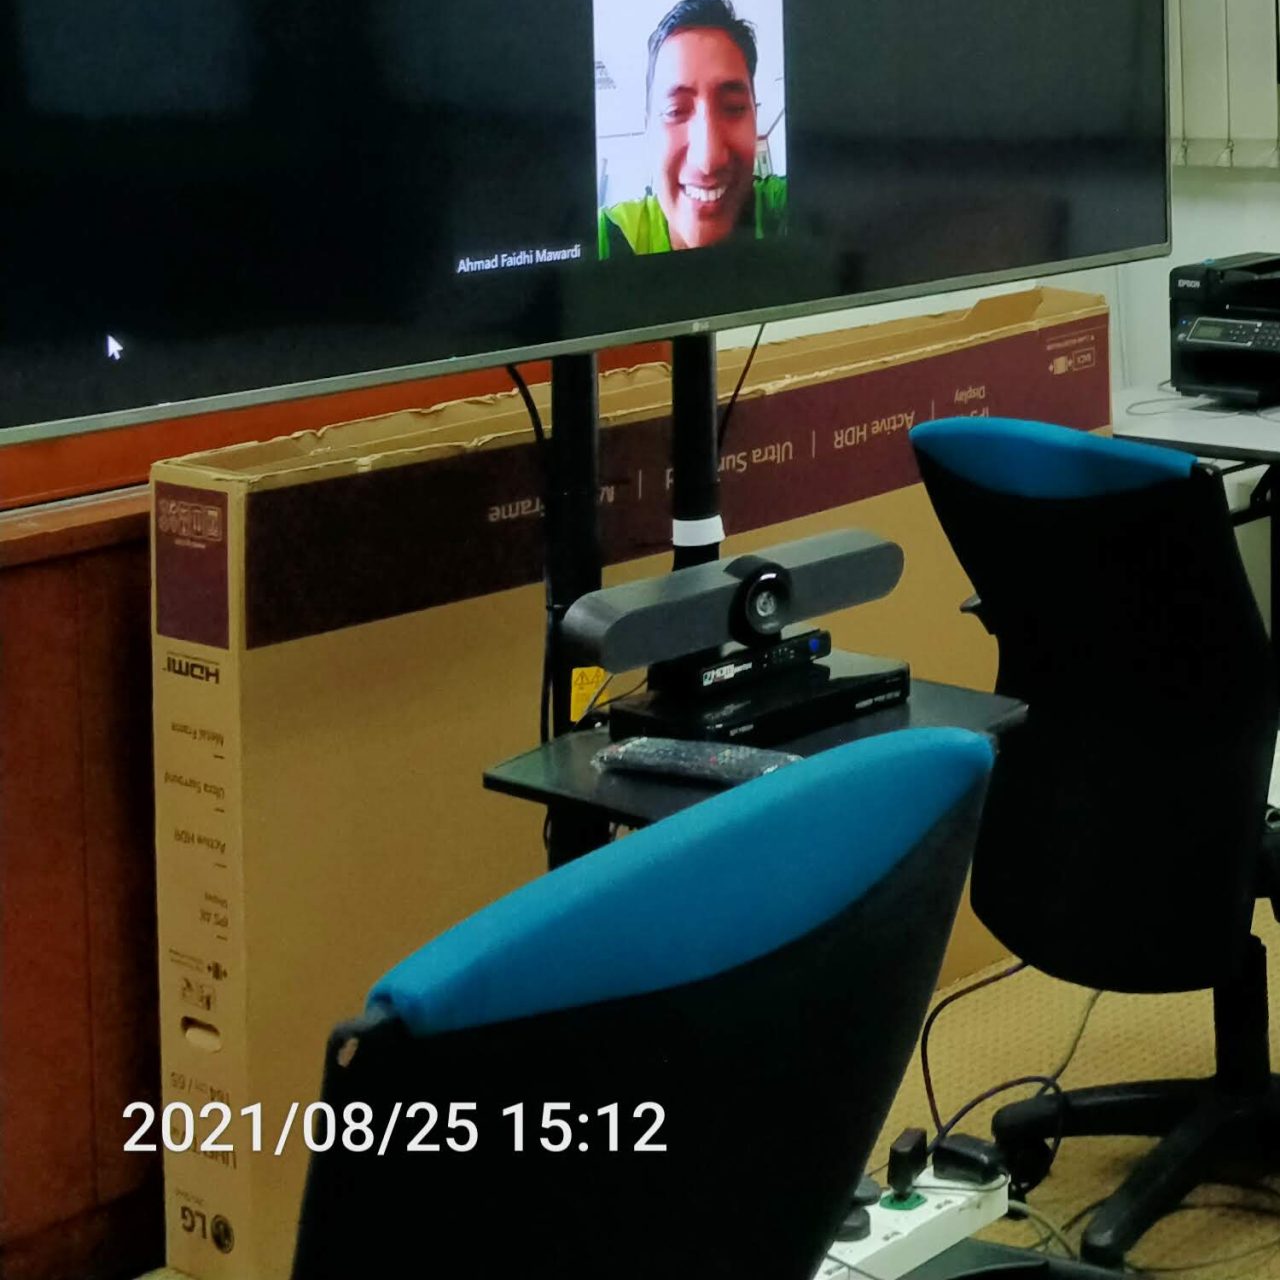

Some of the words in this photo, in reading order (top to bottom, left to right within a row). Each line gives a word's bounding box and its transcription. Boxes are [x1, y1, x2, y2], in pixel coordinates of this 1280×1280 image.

[457, 254, 499, 273] Ahmad
[501, 250, 534, 268] Faidhi
[536, 244, 581, 263] Mawardi
[954, 383, 986, 404] Display
[833, 424, 868, 449] HDR
[871, 410, 916, 439] Active
[751, 440, 795, 466] Ultra
[488, 497, 545, 523] rame
[166, 657, 220, 685] HDMI
[181, 1205, 208, 1240] LG
